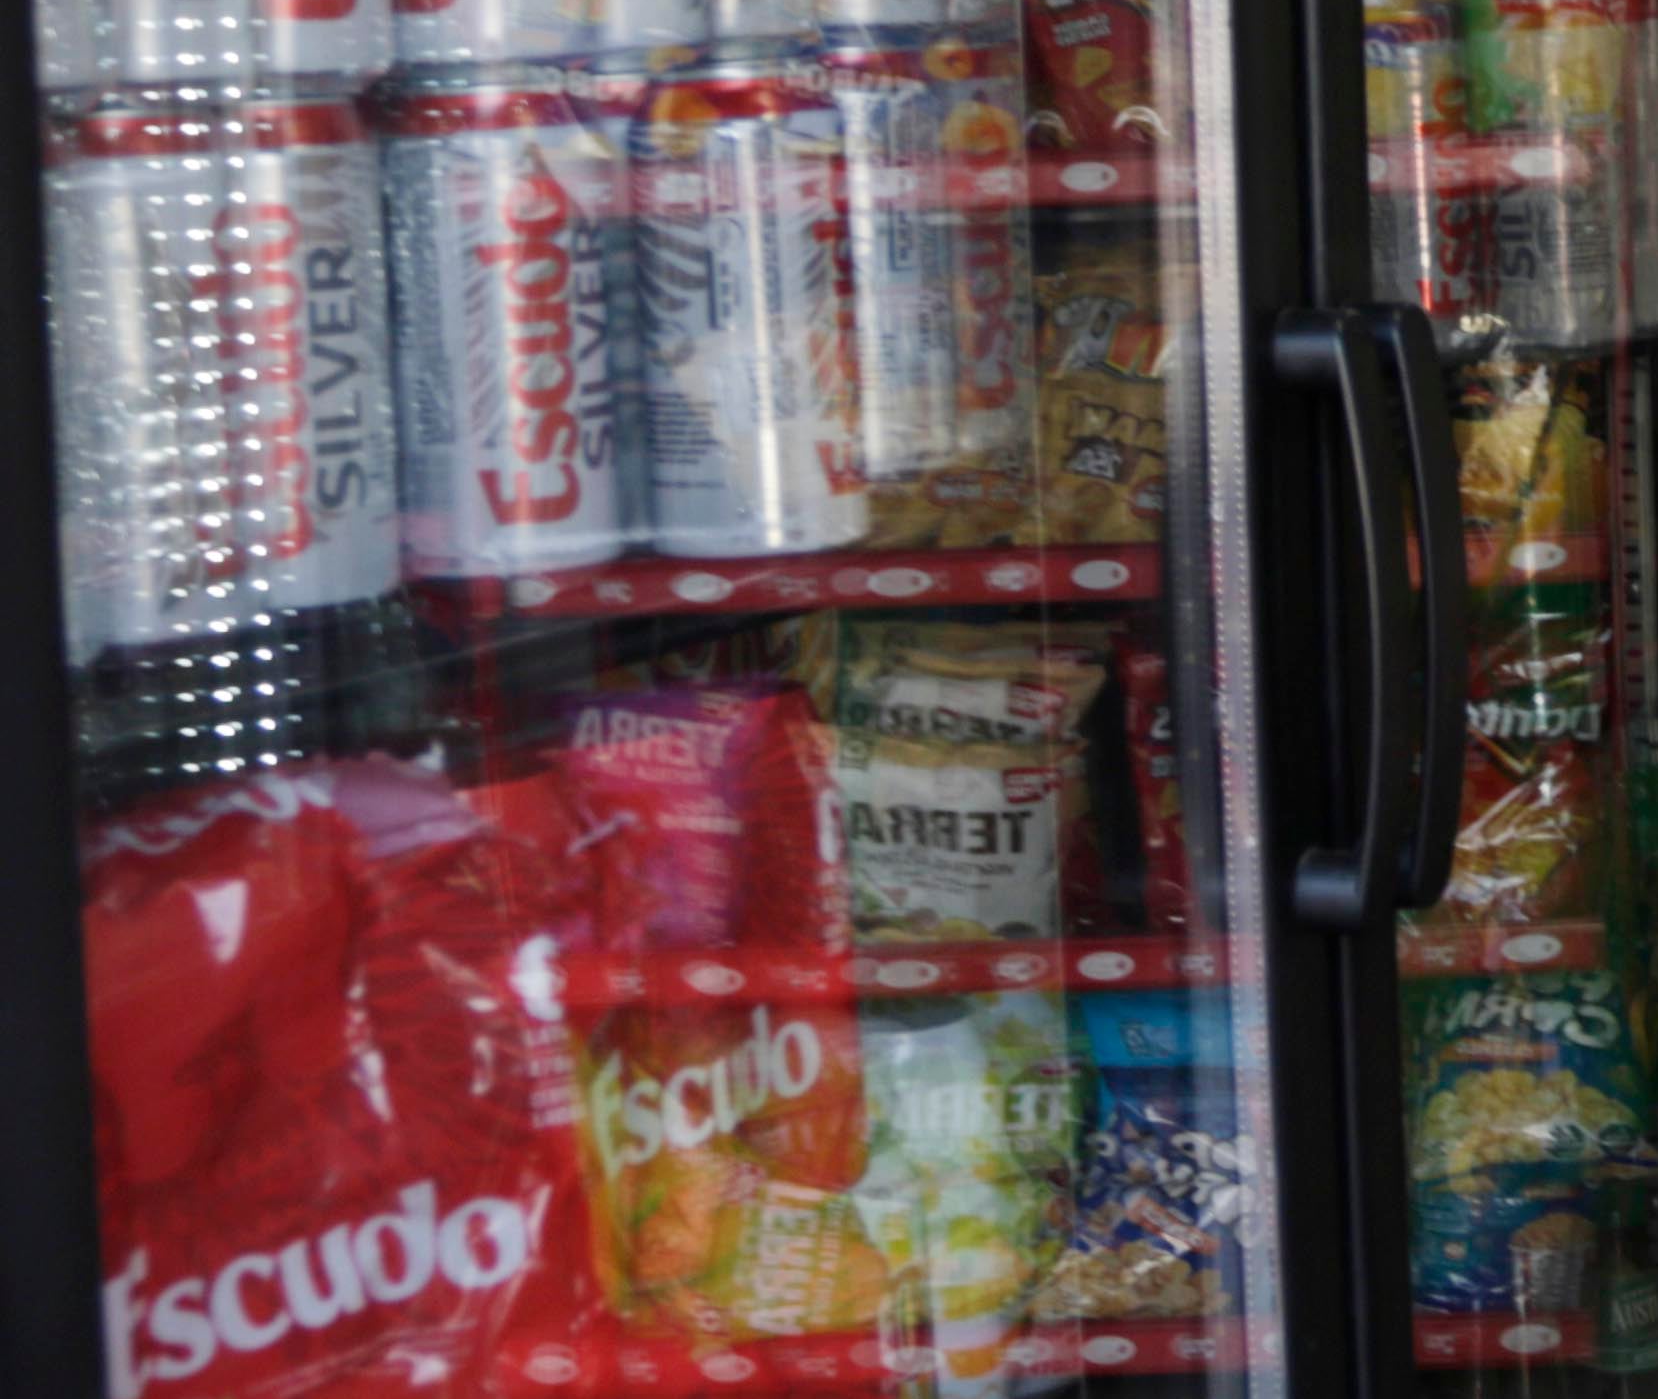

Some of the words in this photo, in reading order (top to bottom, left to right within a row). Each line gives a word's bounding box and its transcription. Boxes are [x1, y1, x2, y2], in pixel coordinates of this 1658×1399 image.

[305, 244, 367, 511] SILVER
[476, 176, 581, 526] Escudo
[592, 1006, 822, 1178] Escudo
[103, 1178, 531, 1399] Escudo
